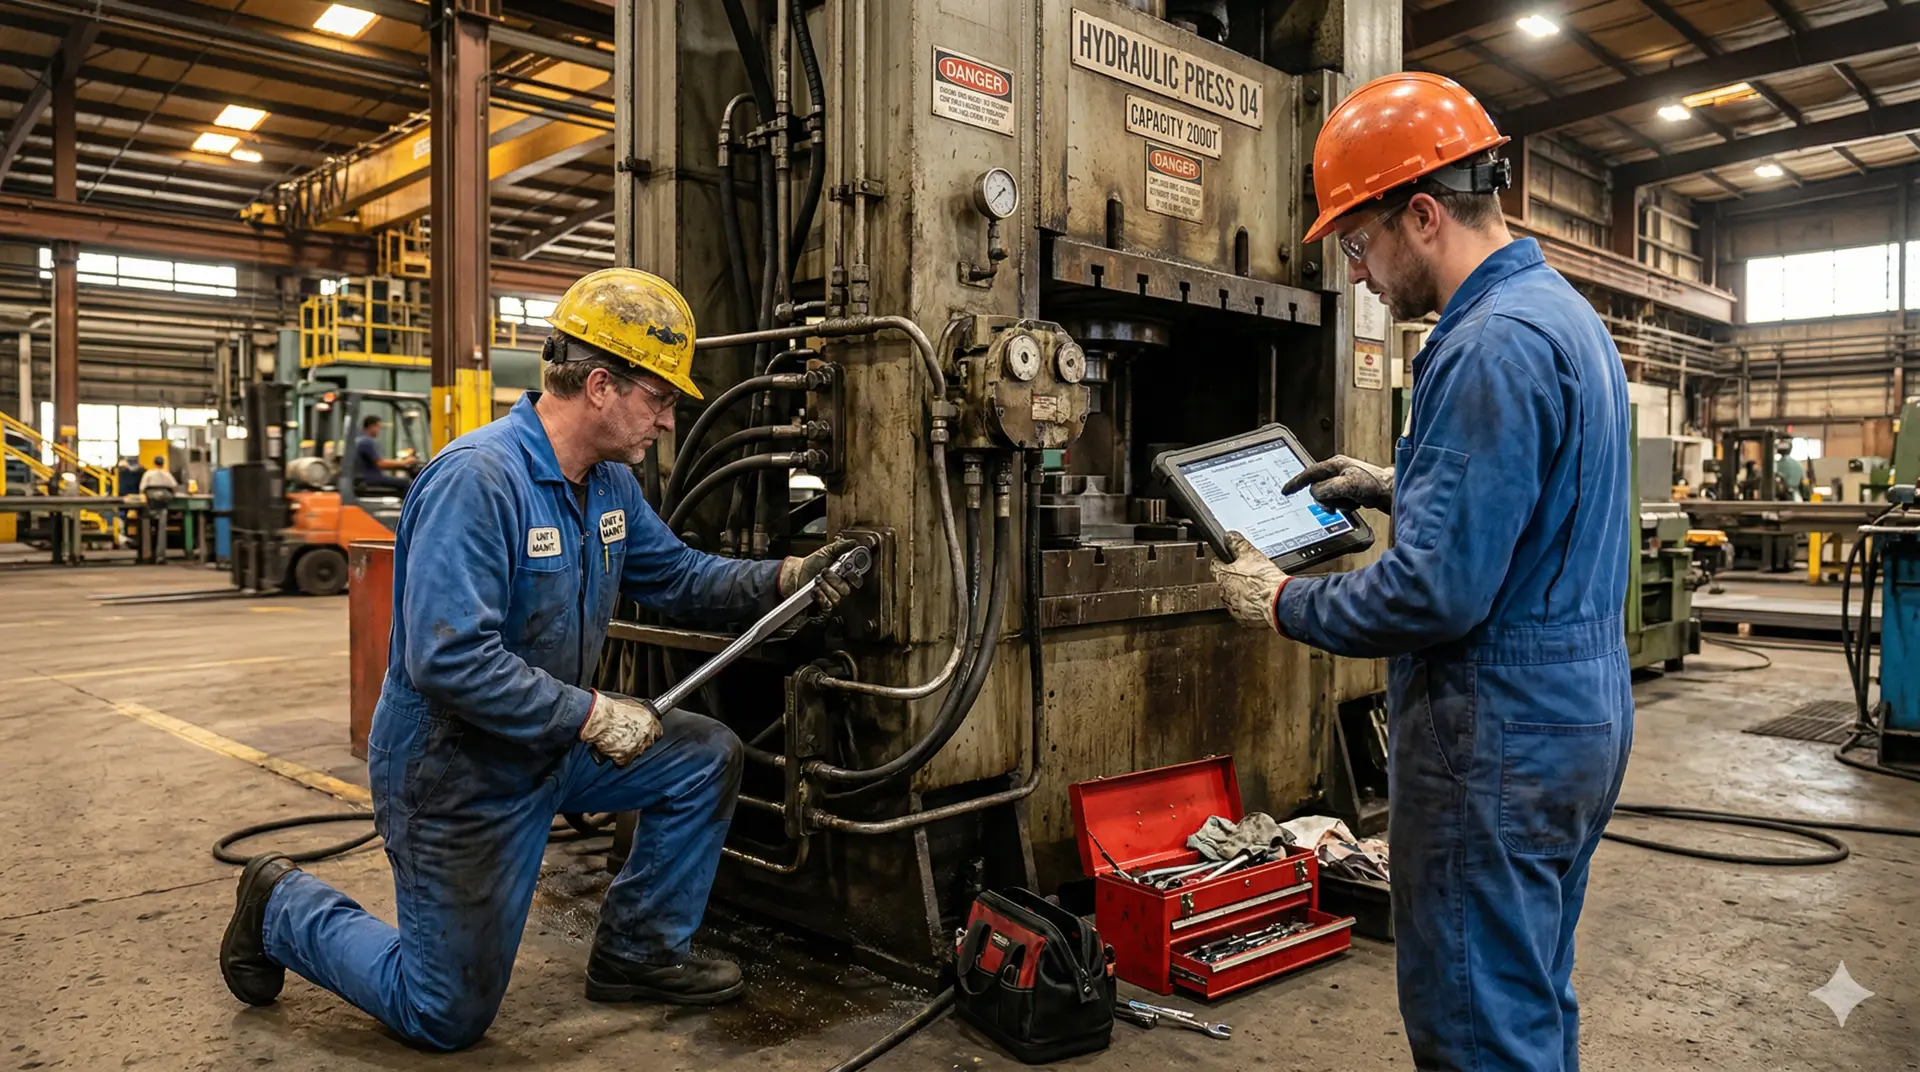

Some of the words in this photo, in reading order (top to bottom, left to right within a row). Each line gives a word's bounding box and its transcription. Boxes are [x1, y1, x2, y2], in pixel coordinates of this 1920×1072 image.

[946, 60, 1003, 93] DANGER
[1080, 19, 1179, 90] HYDRAULIC
[1184, 60, 1235, 111] PRESS
[1239, 83, 1258, 119] 04
[1131, 103, 1183, 139] CAPACITY
[1186, 122, 1218, 150] 2000T
[1154, 152, 1196, 176] DANGER
[601, 515, 617, 527] UNIT
